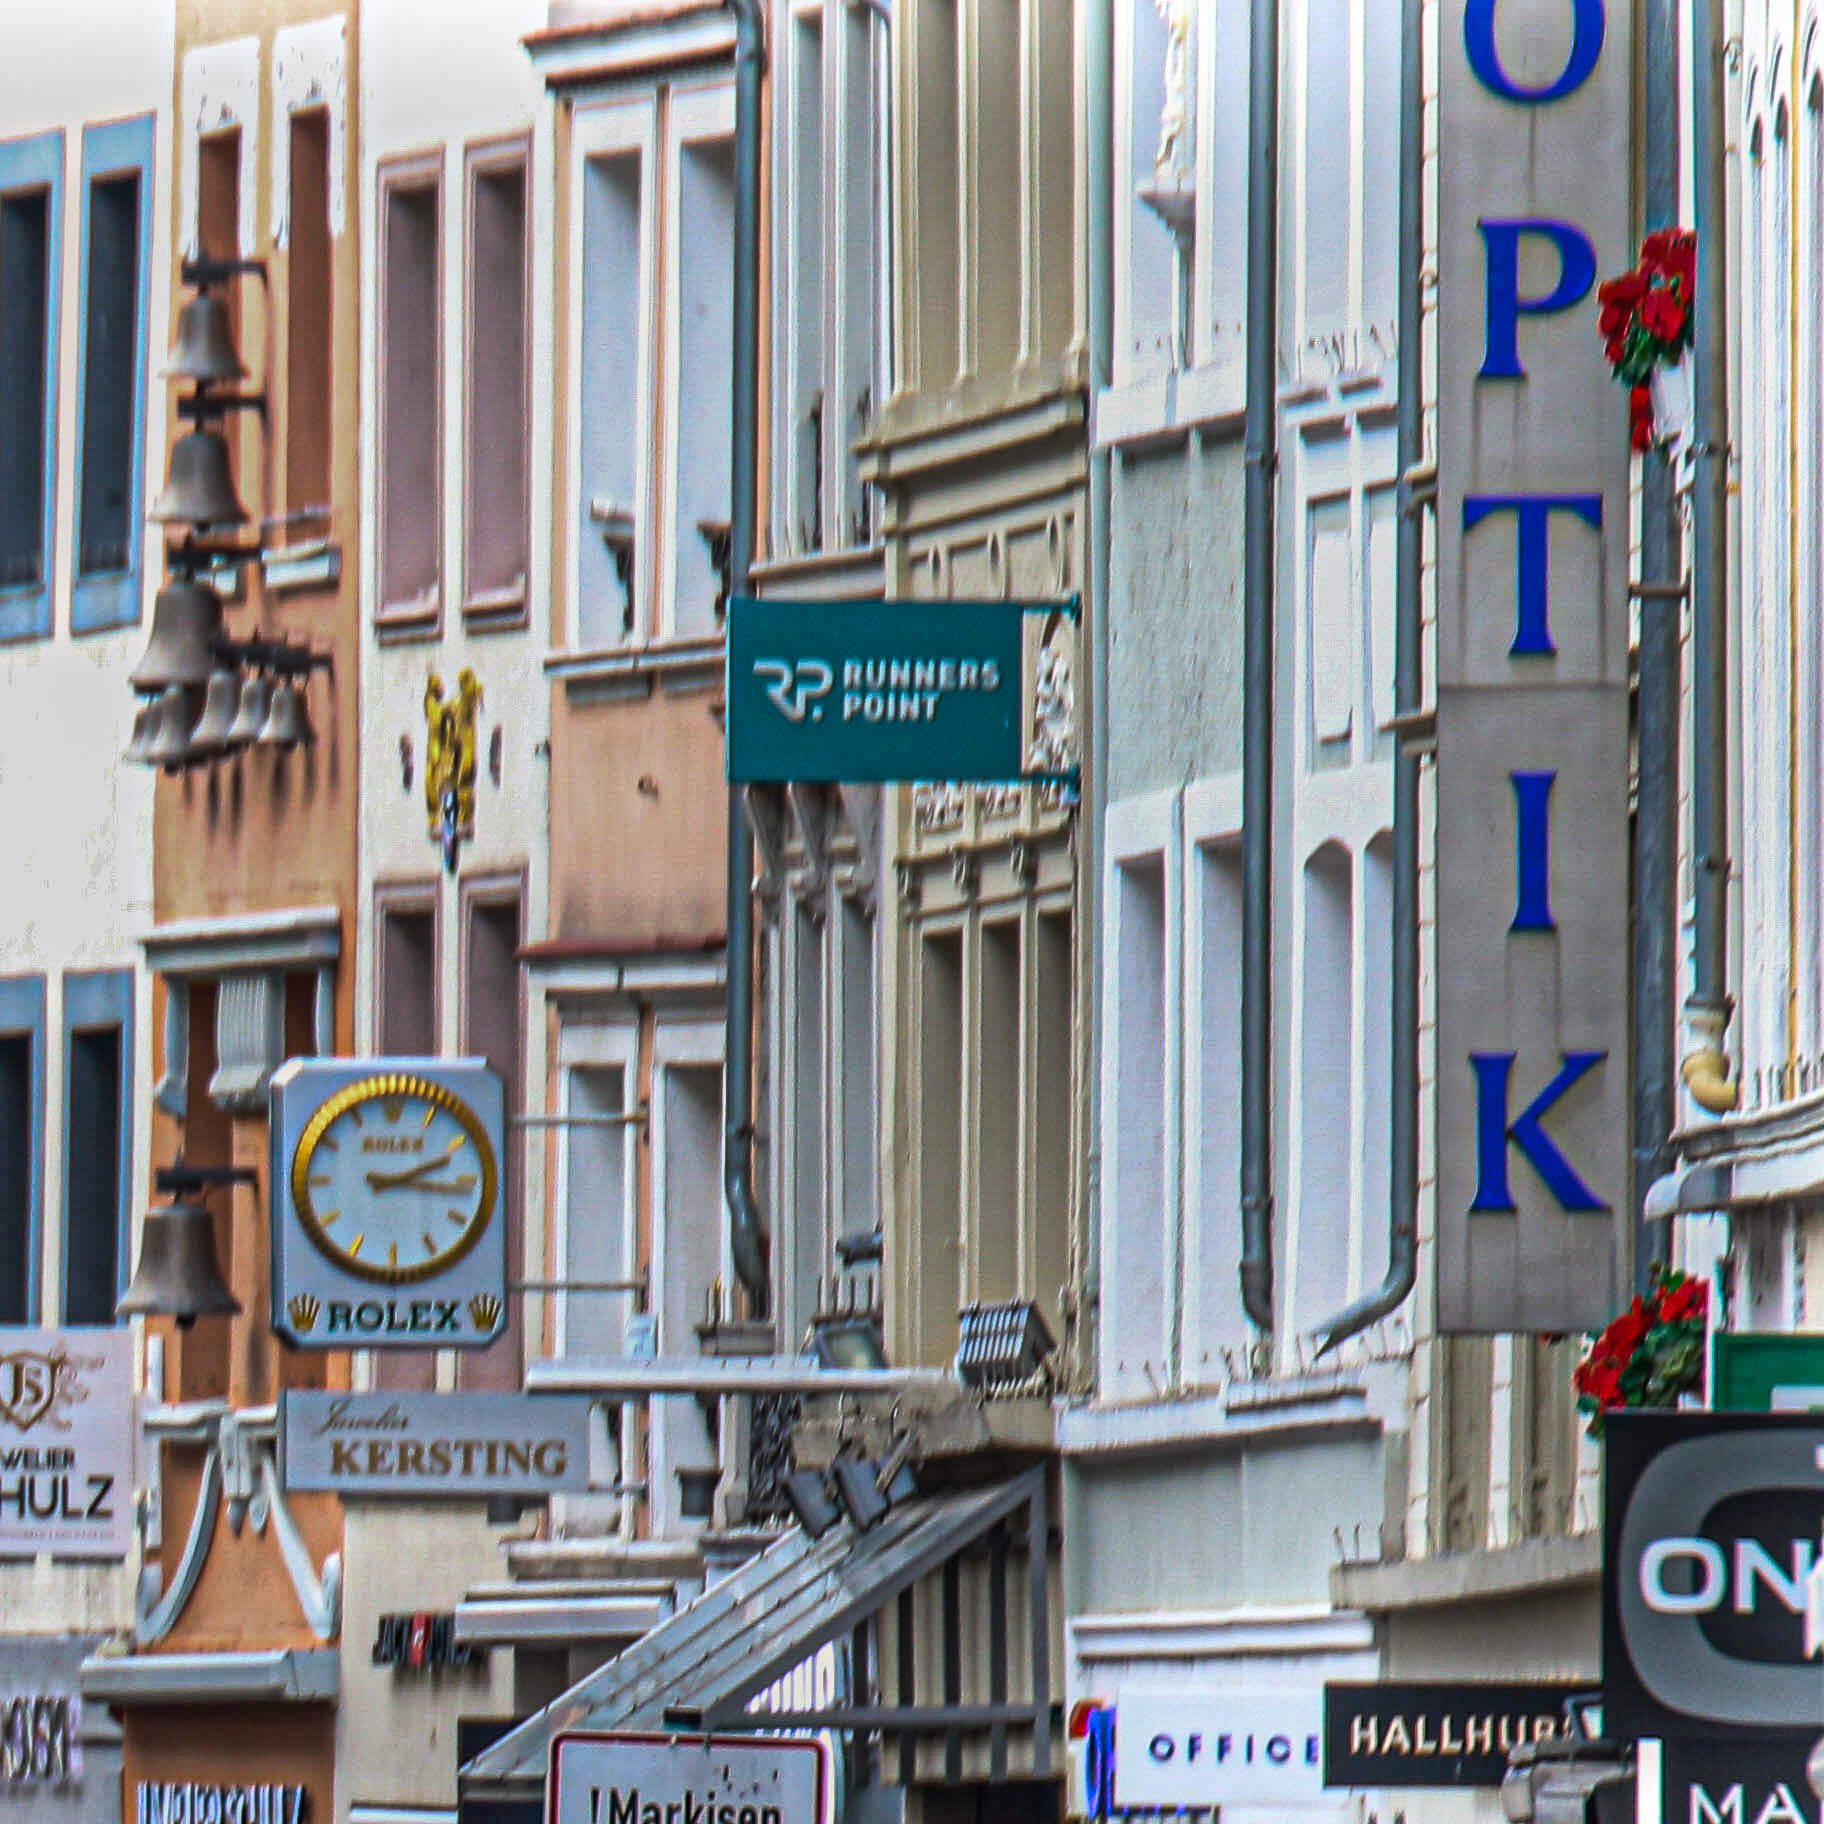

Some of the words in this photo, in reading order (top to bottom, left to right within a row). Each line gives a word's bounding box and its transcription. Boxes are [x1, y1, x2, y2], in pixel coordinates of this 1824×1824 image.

[1464, 0, 1608, 1213] OPTIK
[842, 658, 1000, 690] RUNNERS
[842, 690, 942, 724] POINT
[362, 1136, 425, 1153] ROLEX
[327, 1301, 460, 1333] ROLEX
[330, 1438, 567, 1479] KERSTING
[1149, 1732, 1319, 1763] OFFICE
